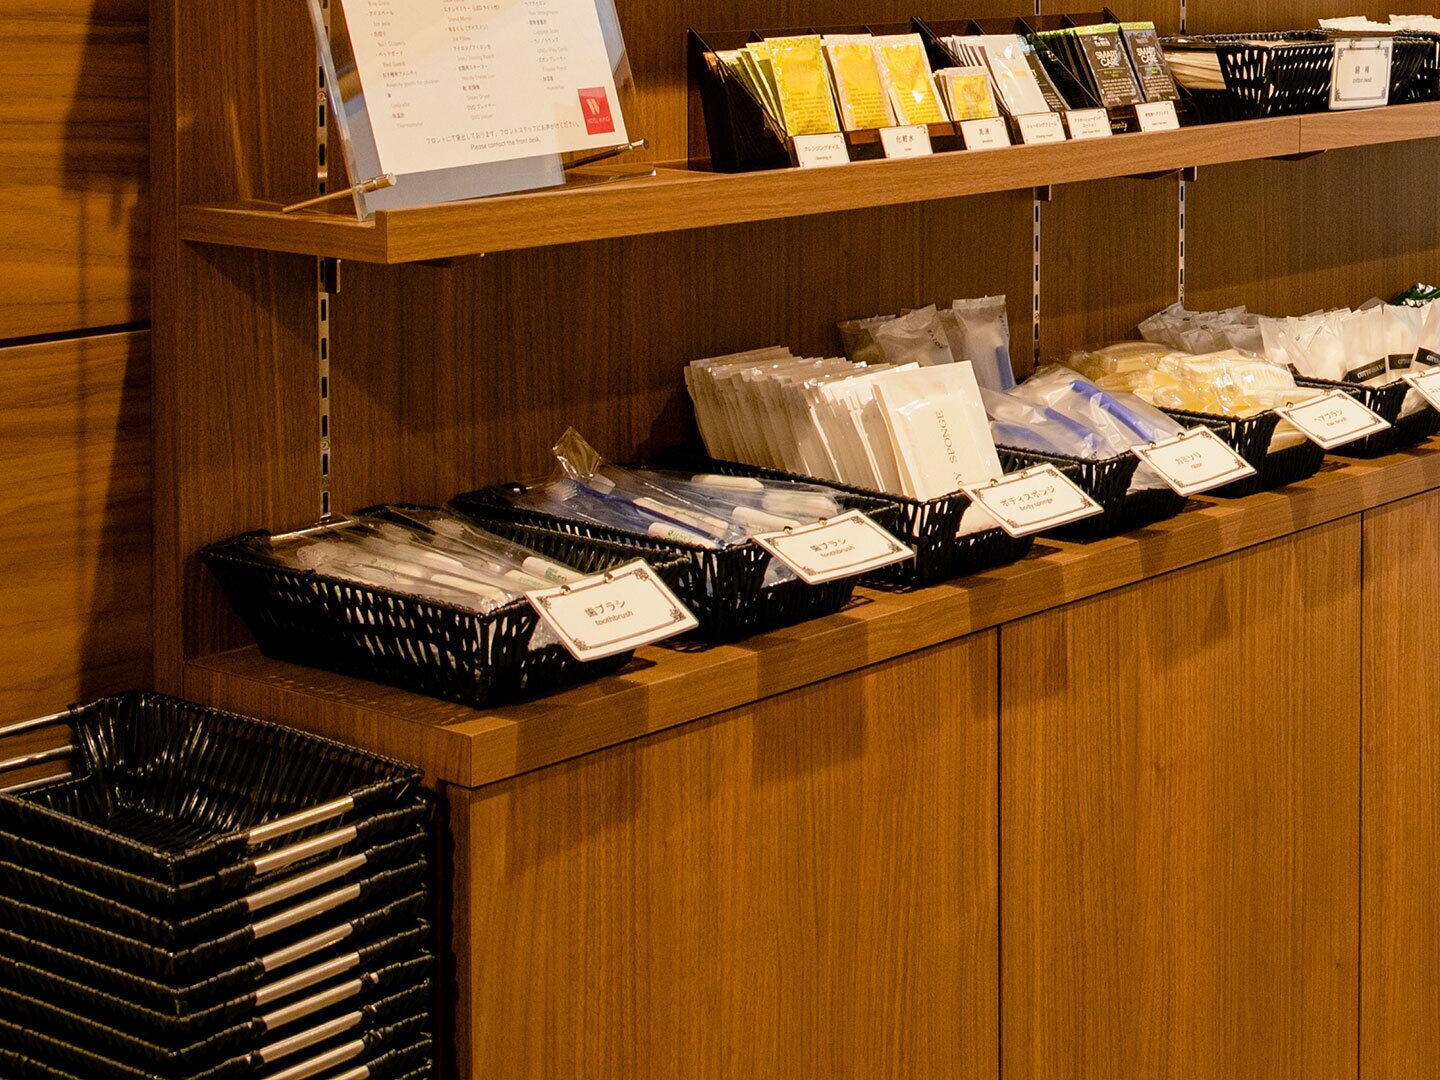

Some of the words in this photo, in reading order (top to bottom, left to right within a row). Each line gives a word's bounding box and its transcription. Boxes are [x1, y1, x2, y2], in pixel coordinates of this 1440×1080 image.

[935, 409, 958, 465] SPONGE
[1174, 451, 1203, 466] カミソリ
[809, 536, 848, 552] 歯ブラシ
[584, 598, 627, 619] 歯ブラシ
[594, 609, 634, 626] toothbrush
